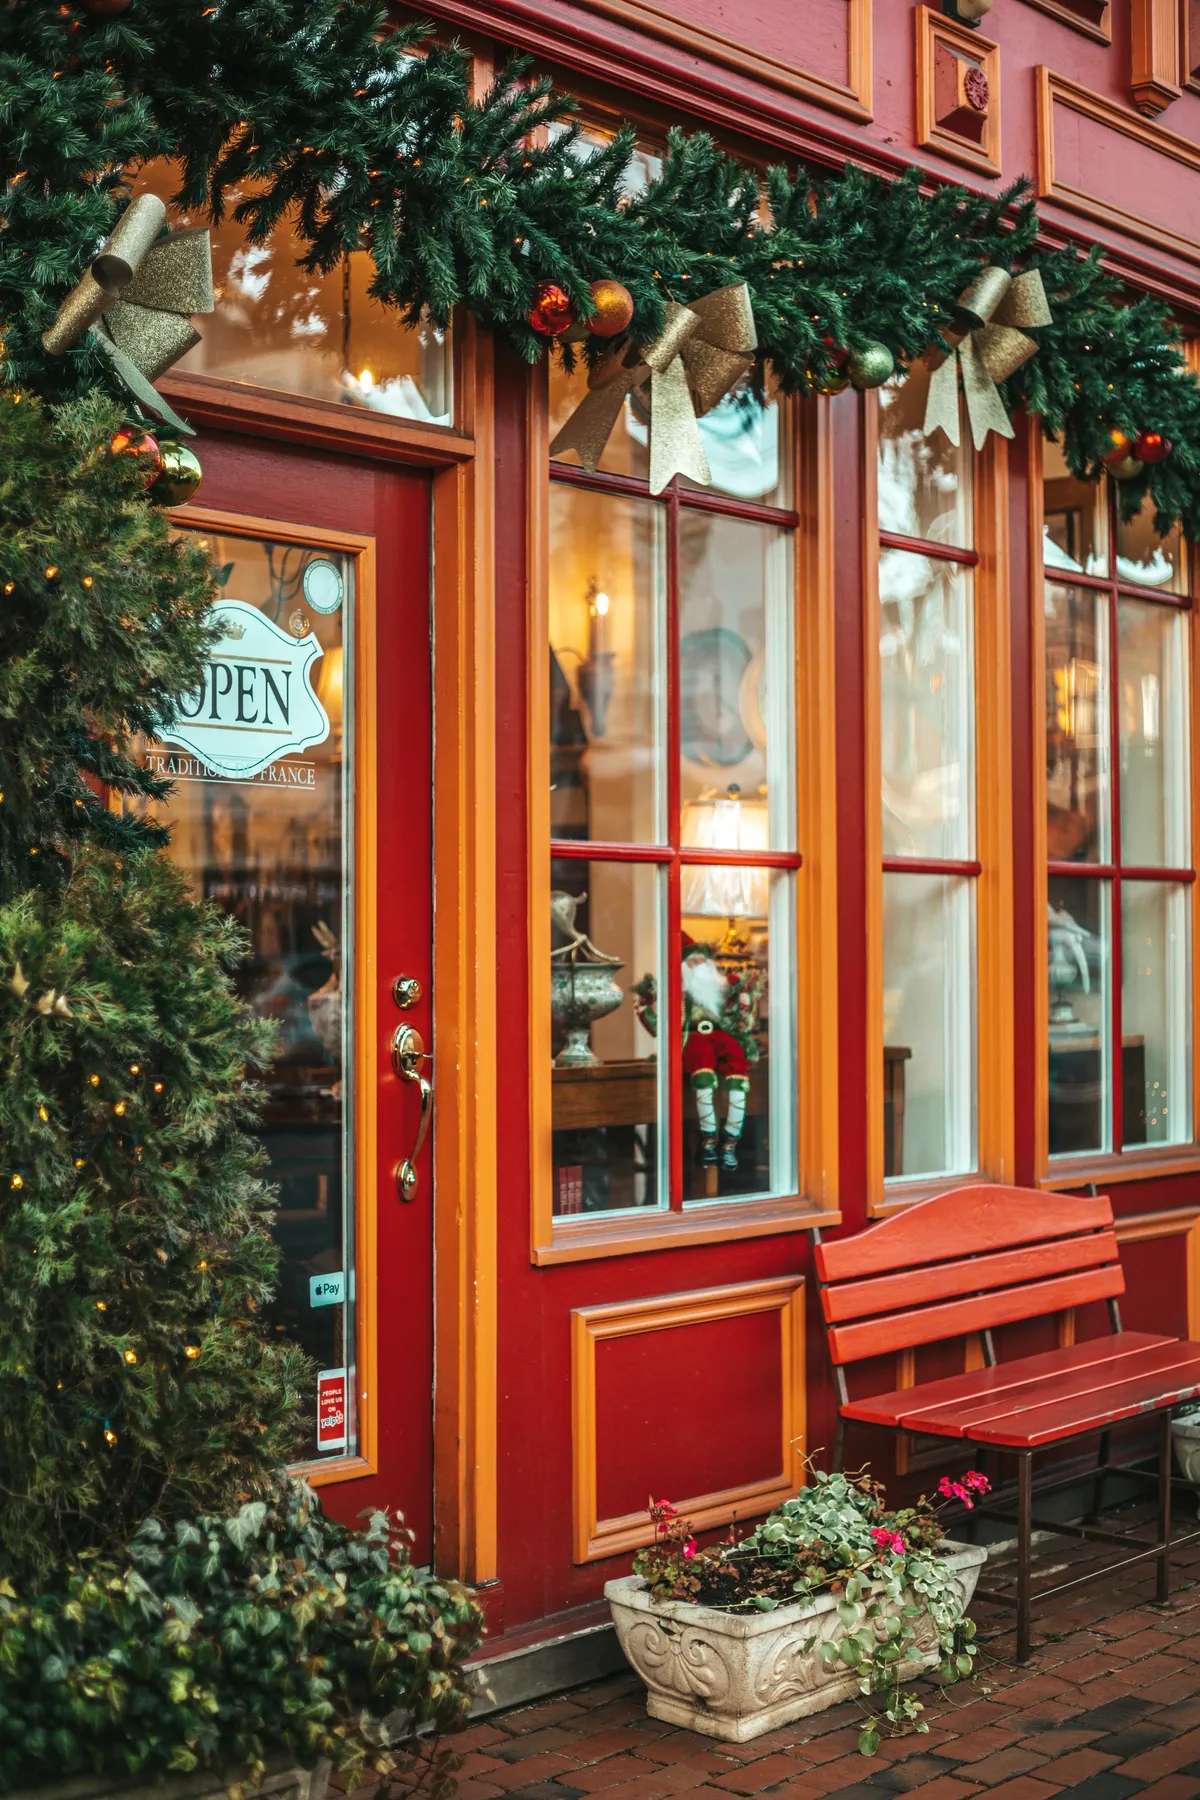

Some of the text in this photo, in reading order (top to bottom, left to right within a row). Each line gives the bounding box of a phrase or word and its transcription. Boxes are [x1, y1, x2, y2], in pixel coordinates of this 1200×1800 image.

[146, 755, 229, 778] TRADITION
[260, 766, 315, 785] FRANCE
[323, 1283, 340, 1295] Pay
[322, 1388, 342, 1397] PEOPLE
[321, 1416, 337, 1428] yelp
